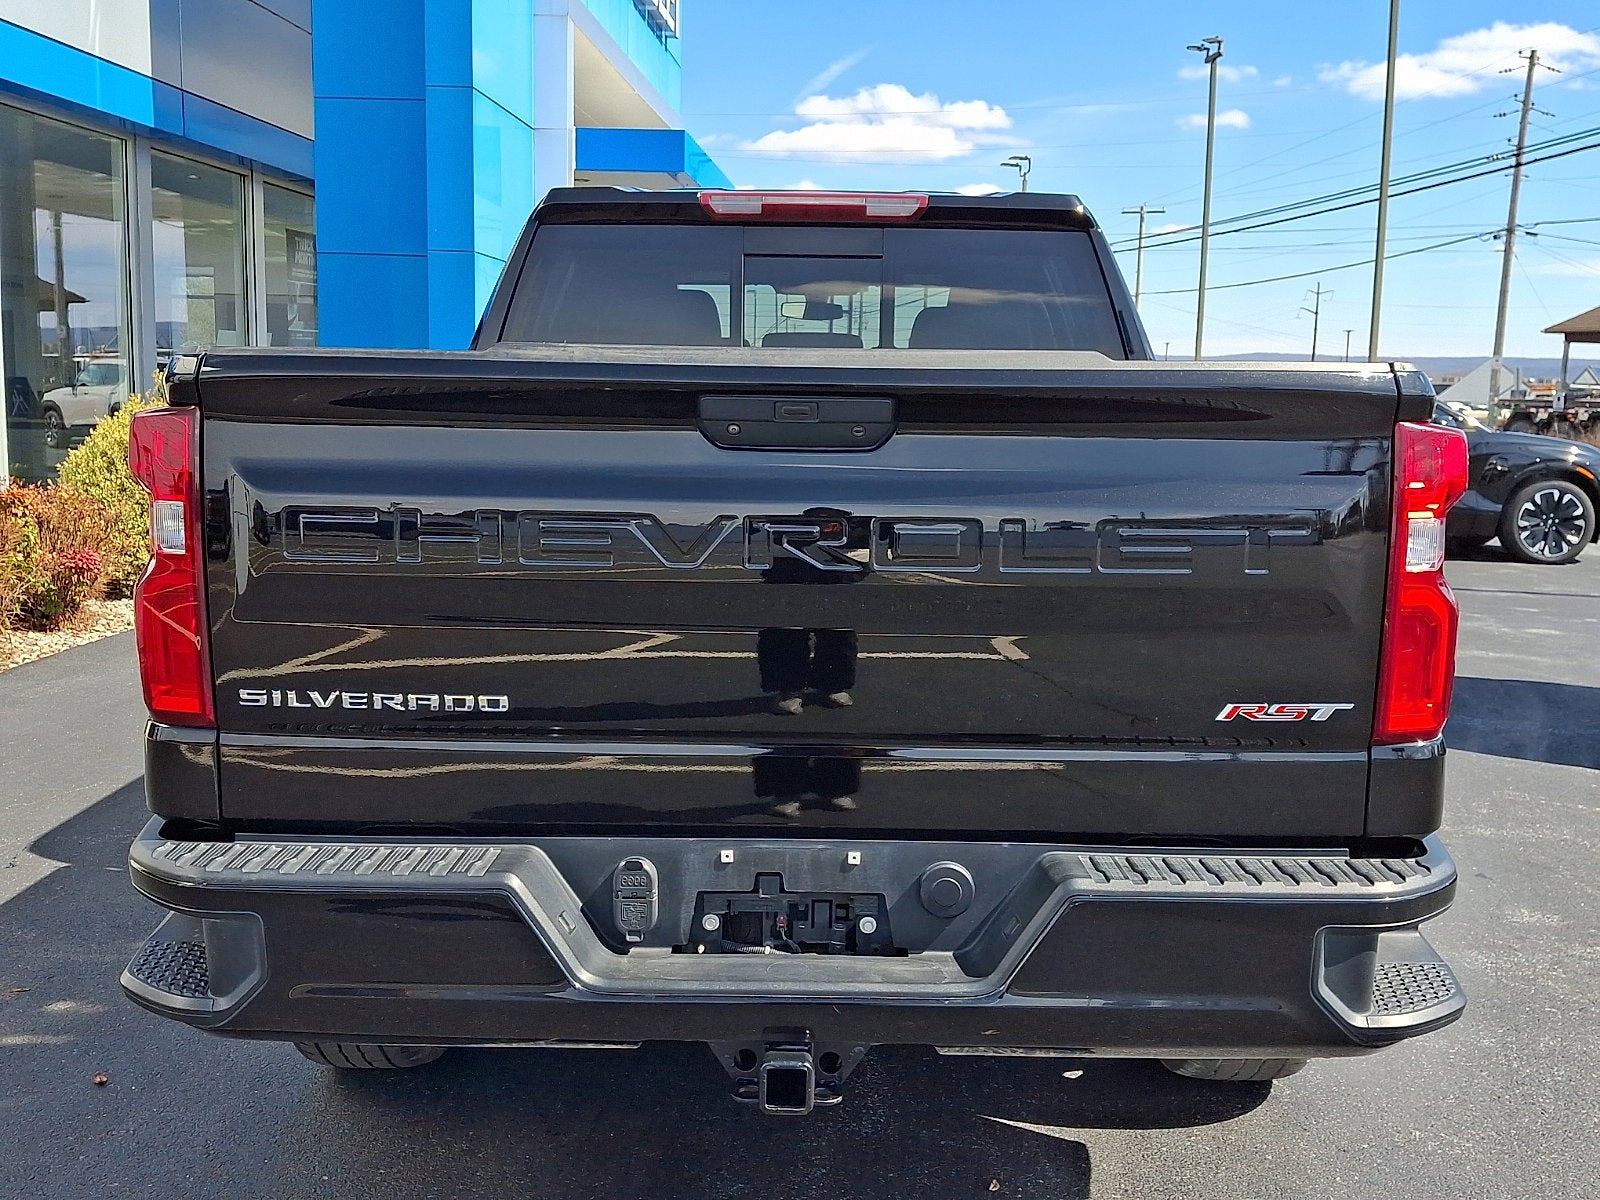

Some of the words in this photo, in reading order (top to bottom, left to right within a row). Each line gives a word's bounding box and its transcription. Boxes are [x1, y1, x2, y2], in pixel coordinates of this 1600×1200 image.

[281, 505, 1313, 575] CHEVROLET
[238, 688, 510, 712] SILVERADO
[1214, 702, 1355, 722] RST
